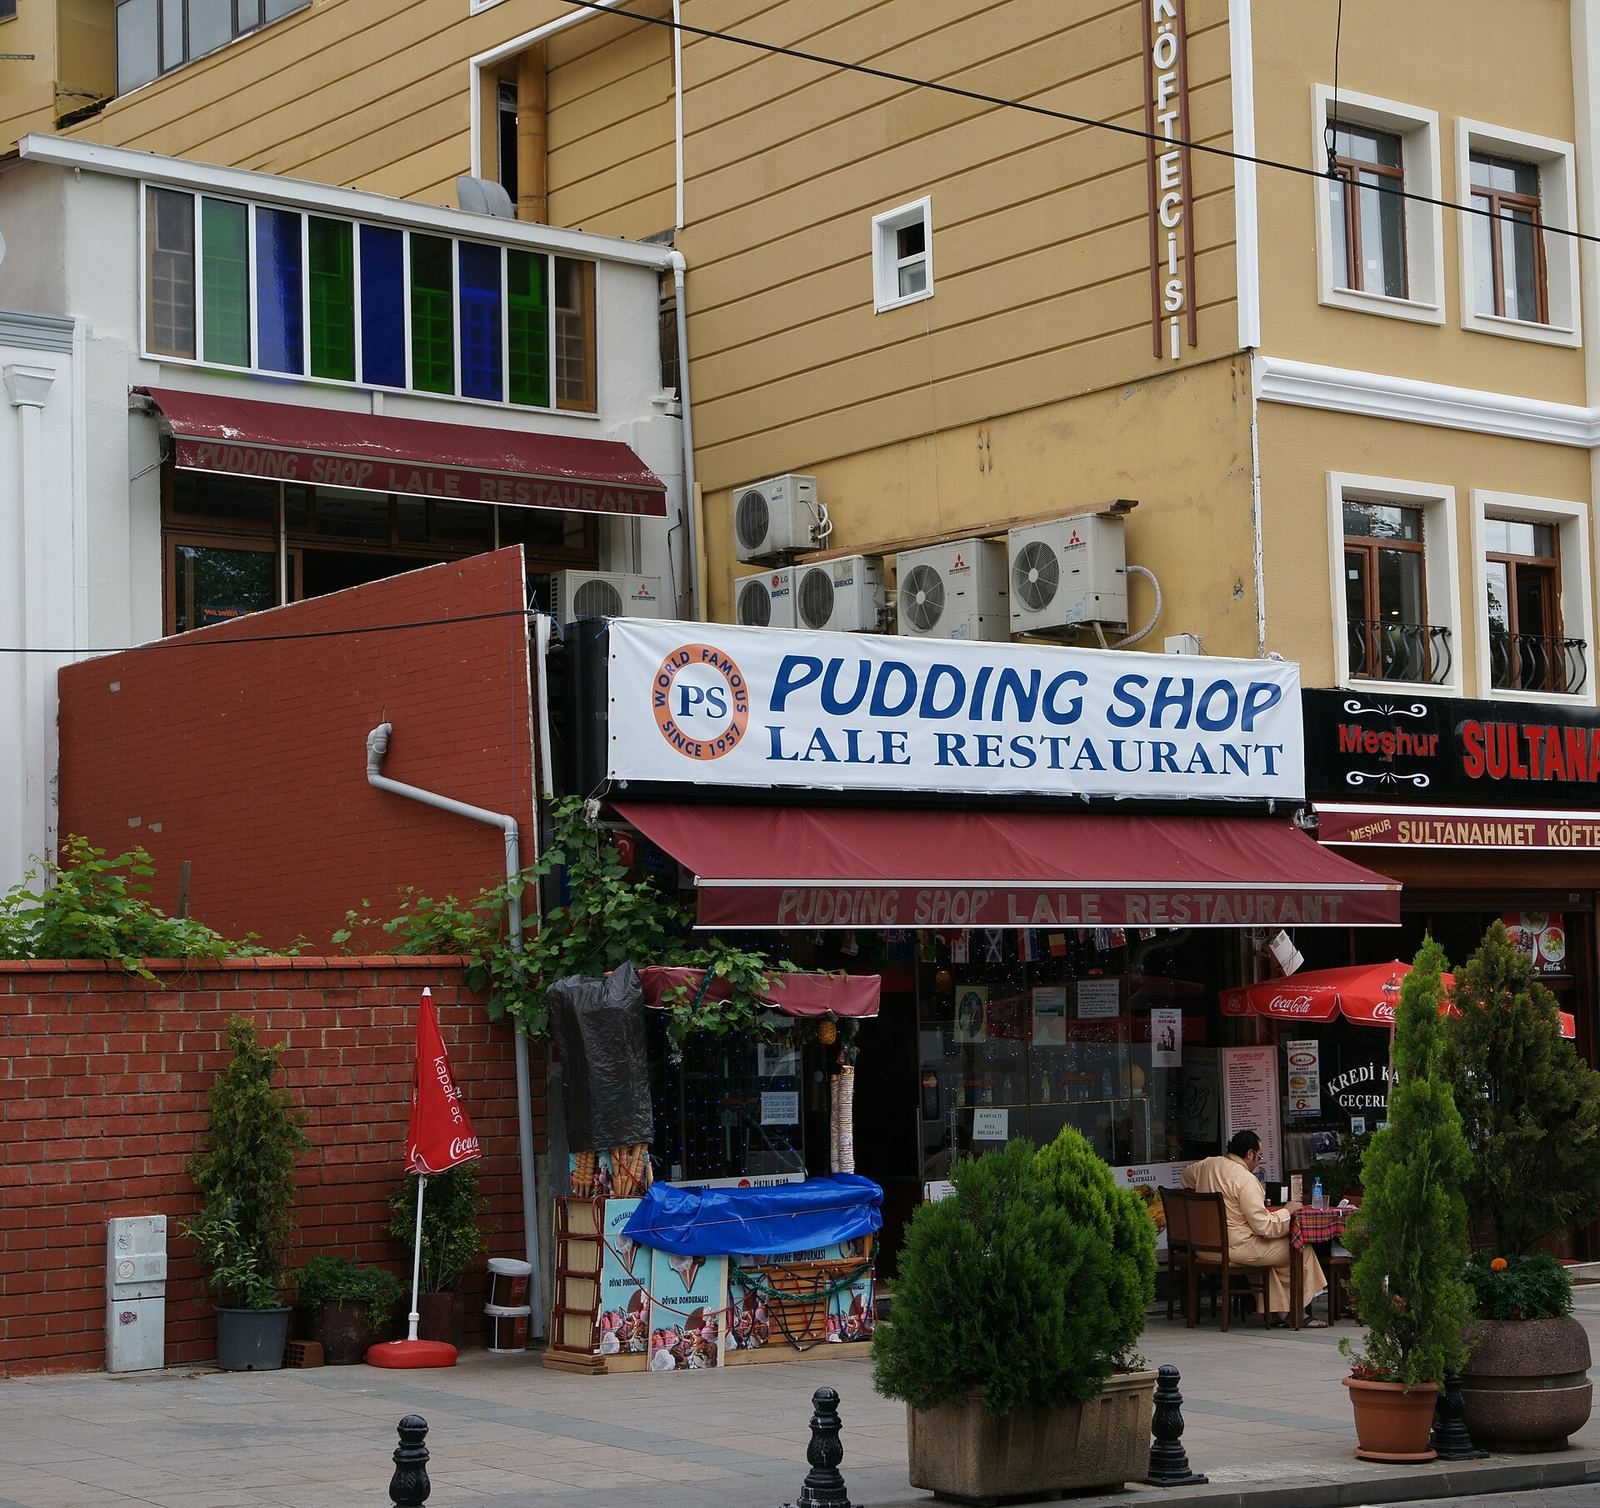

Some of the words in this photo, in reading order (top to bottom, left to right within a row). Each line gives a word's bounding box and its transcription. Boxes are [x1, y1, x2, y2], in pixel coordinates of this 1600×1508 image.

[197, 443, 298, 479] PUDDING
[310, 457, 374, 488] SHOP
[388, 468, 461, 498] LALE
[479, 478, 650, 514] RESTAURANT
[771, 588, 790, 598] BEKO
[780, 575, 789, 584] LG
[834, 578, 854, 588] BEKO
[654, 650, 691, 708] WORLD
[701, 648, 748, 713] FAMOUS
[769, 654, 1089, 726] PUDDING
[1105, 673, 1283, 733] SHOP
[676, 684, 728, 719] PS
[662, 720, 702, 757] SINCE
[708, 722, 741, 757] 1957
[764, 725, 912, 765] LALE
[933, 732, 1284, 777] RESTAURANT
[1338, 723, 1440, 763] Meşhur
[1350, 819, 1392, 842] MEŞHUR
[1397, 820, 1536, 845] SULTANAHMET
[778, 889, 899, 925] PUDDING
[1008, 893, 1102, 924] LALE
[1125, 893, 1344, 924] RESTAURANT
[433, 1055, 456, 1103] kapak
[450, 1106, 463, 1124] aç
[1327, 1062, 1375, 1096] KREDİ
